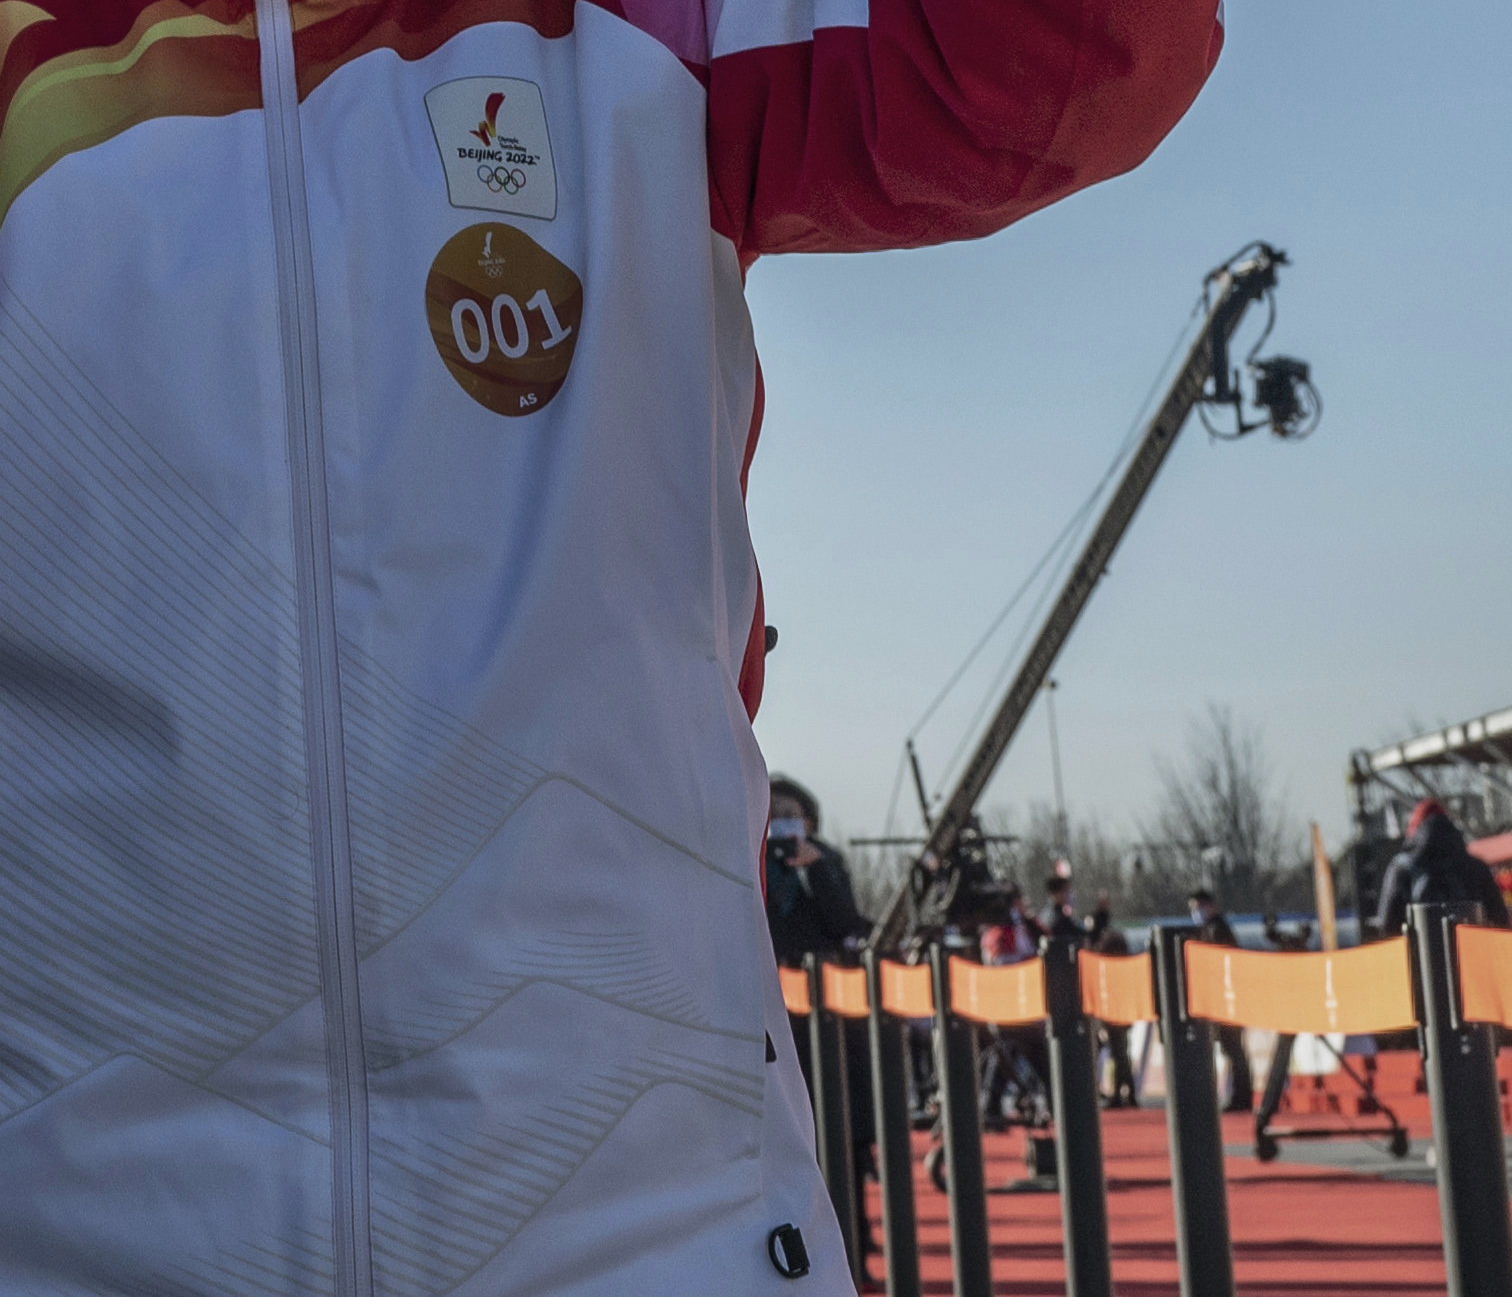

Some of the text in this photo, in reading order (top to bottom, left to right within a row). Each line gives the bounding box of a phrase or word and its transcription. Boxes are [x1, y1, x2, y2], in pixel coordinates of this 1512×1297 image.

[457, 148, 502, 162] BEIJING
[451, 289, 572, 364] 001
[519, 393, 538, 408] AS
